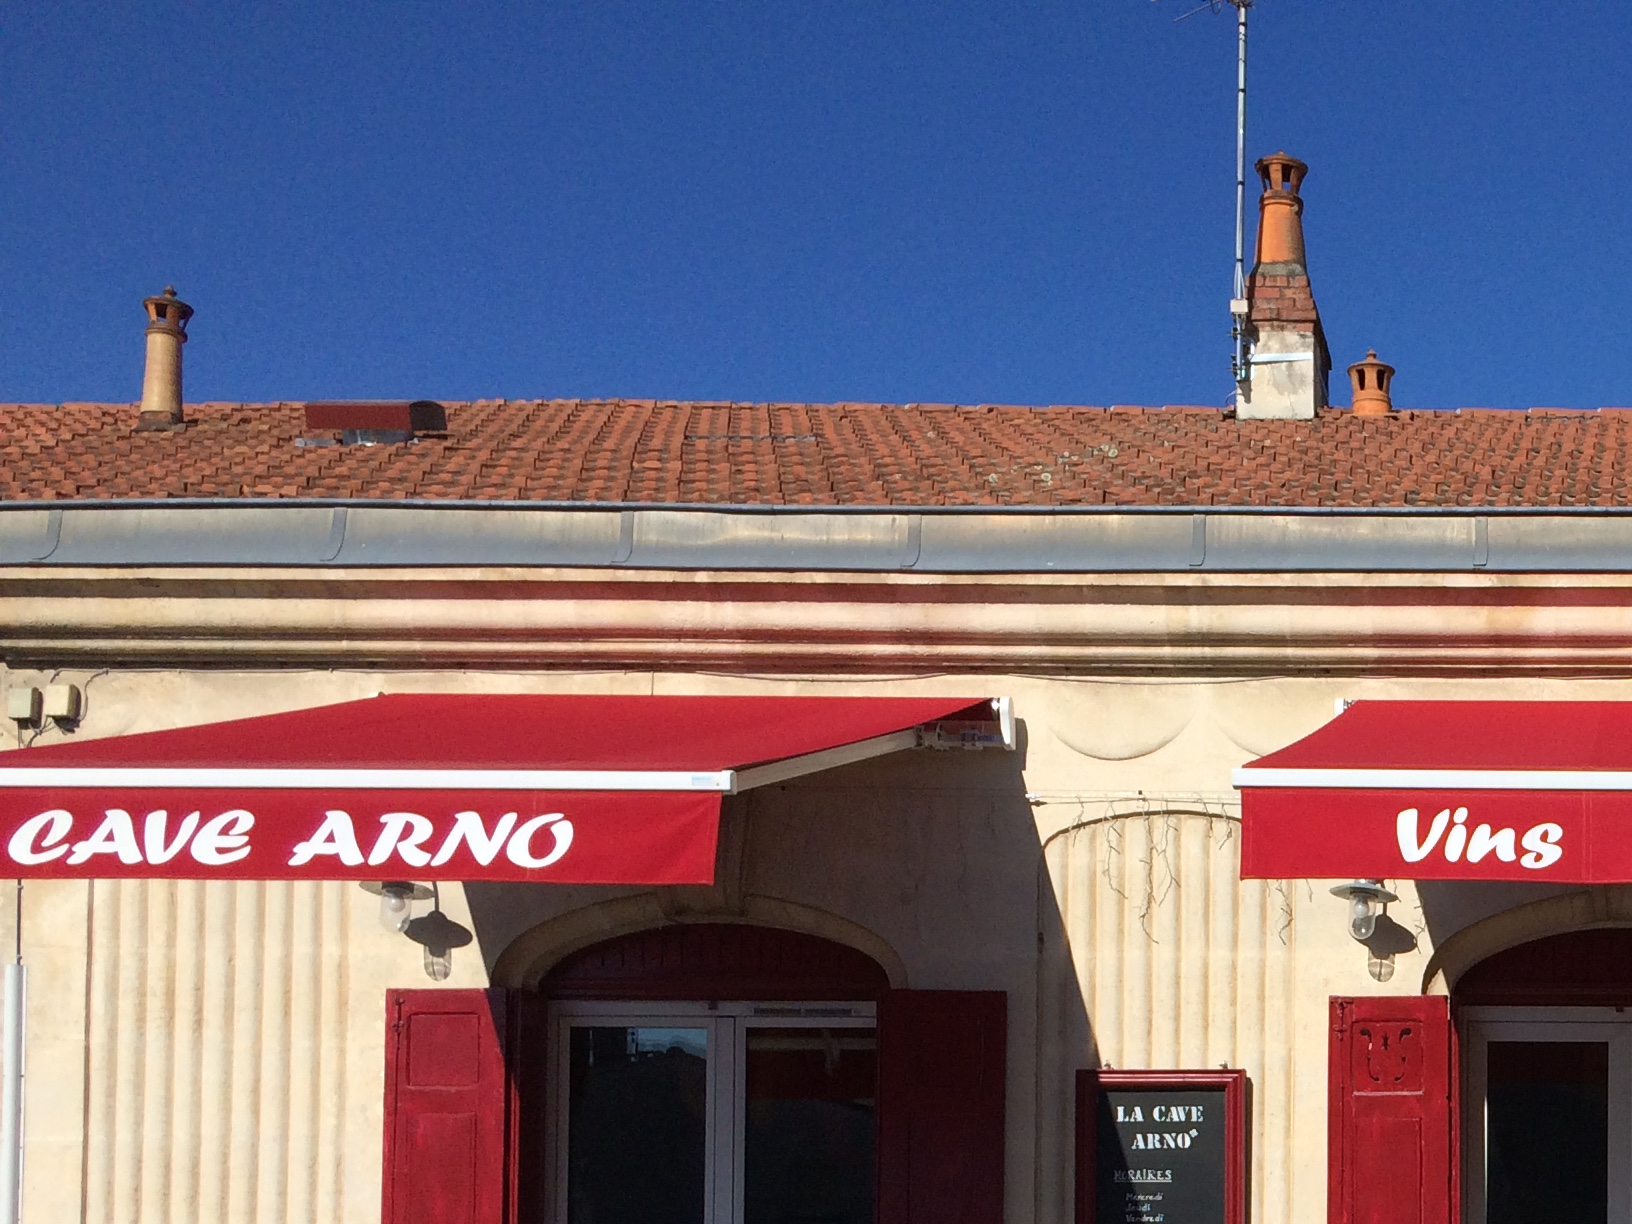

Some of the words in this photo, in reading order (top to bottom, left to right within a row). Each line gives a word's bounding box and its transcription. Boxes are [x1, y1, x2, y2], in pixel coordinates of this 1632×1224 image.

[8, 809, 254, 865] CAVE
[288, 810, 573, 868] ARNO
[1397, 807, 1563, 868] Vins
[1116, 1105, 1144, 1122] LA
[1152, 1105, 1204, 1122] CAVE
